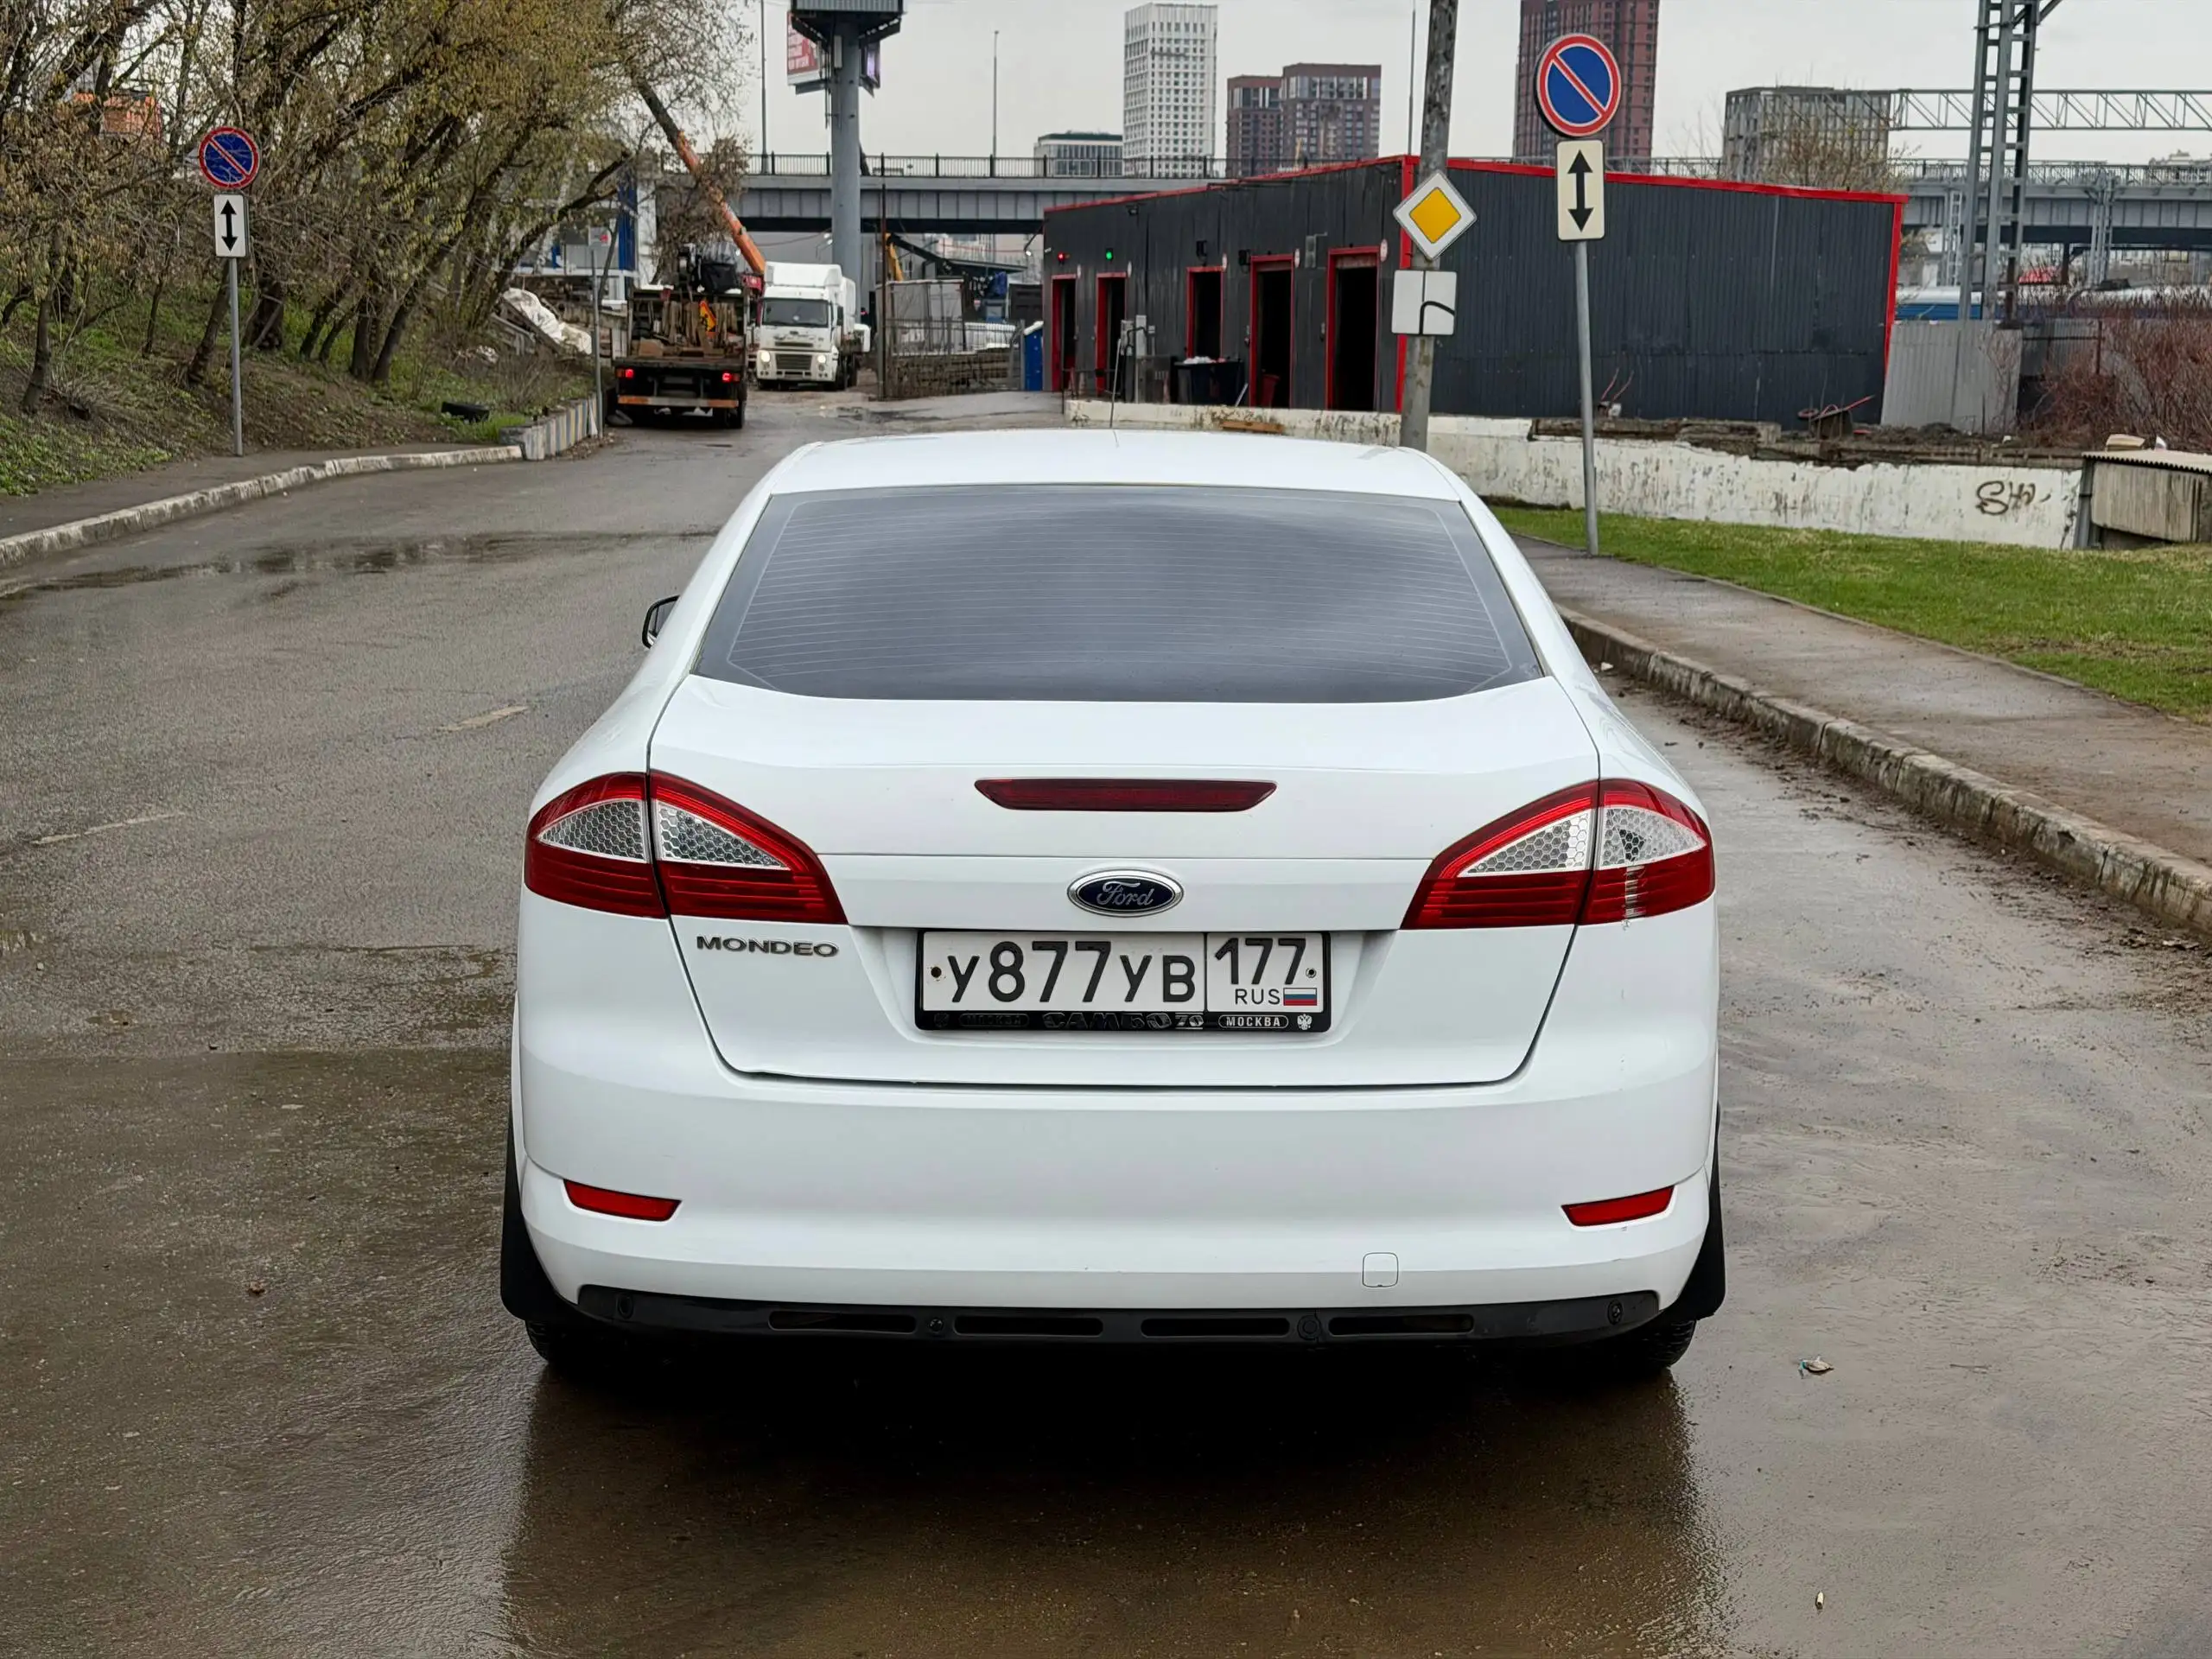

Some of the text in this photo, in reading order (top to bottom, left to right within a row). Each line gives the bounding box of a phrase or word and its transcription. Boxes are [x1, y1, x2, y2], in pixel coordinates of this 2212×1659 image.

[1096, 880, 1155, 906] Ford
[696, 935, 840, 957] MONDEO
[947, 938, 1306, 1002] У877УВ 177
[1234, 988, 1281, 1005] RUS
[1175, 1014, 1205, 1027] 70
[1225, 1016, 1281, 1027] МОСКВА
